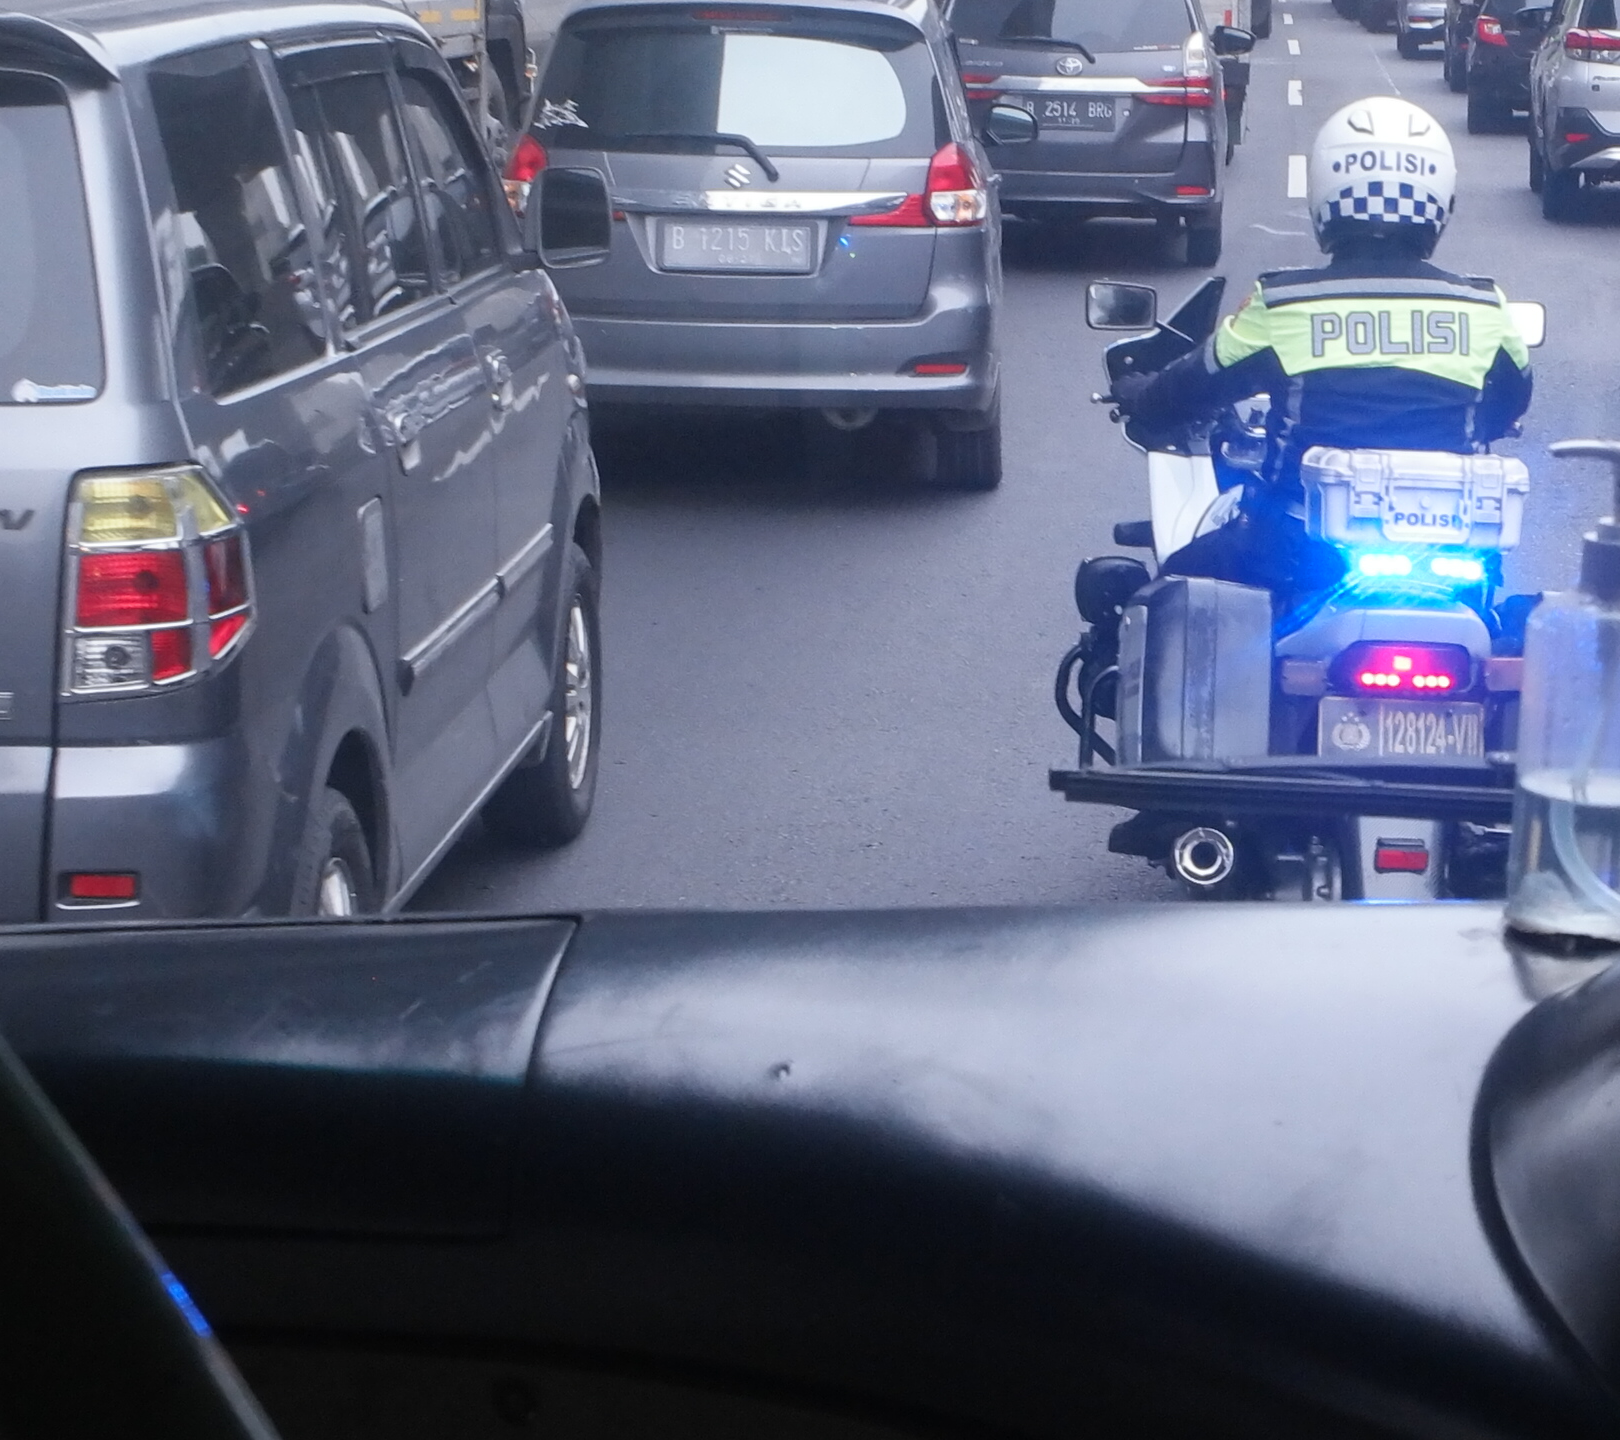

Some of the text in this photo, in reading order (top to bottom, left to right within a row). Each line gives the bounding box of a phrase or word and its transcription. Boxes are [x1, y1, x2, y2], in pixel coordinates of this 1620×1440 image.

[1044, 100, 1077, 118] 2514
[1088, 102, 1113, 119] BRG
[1344, 150, 1426, 176] POLISI
[671, 226, 685, 250] B
[700, 227, 750, 252] 1215
[1310, 310, 1470, 358] POLISI
[1393, 511, 1463, 531] POLISI
